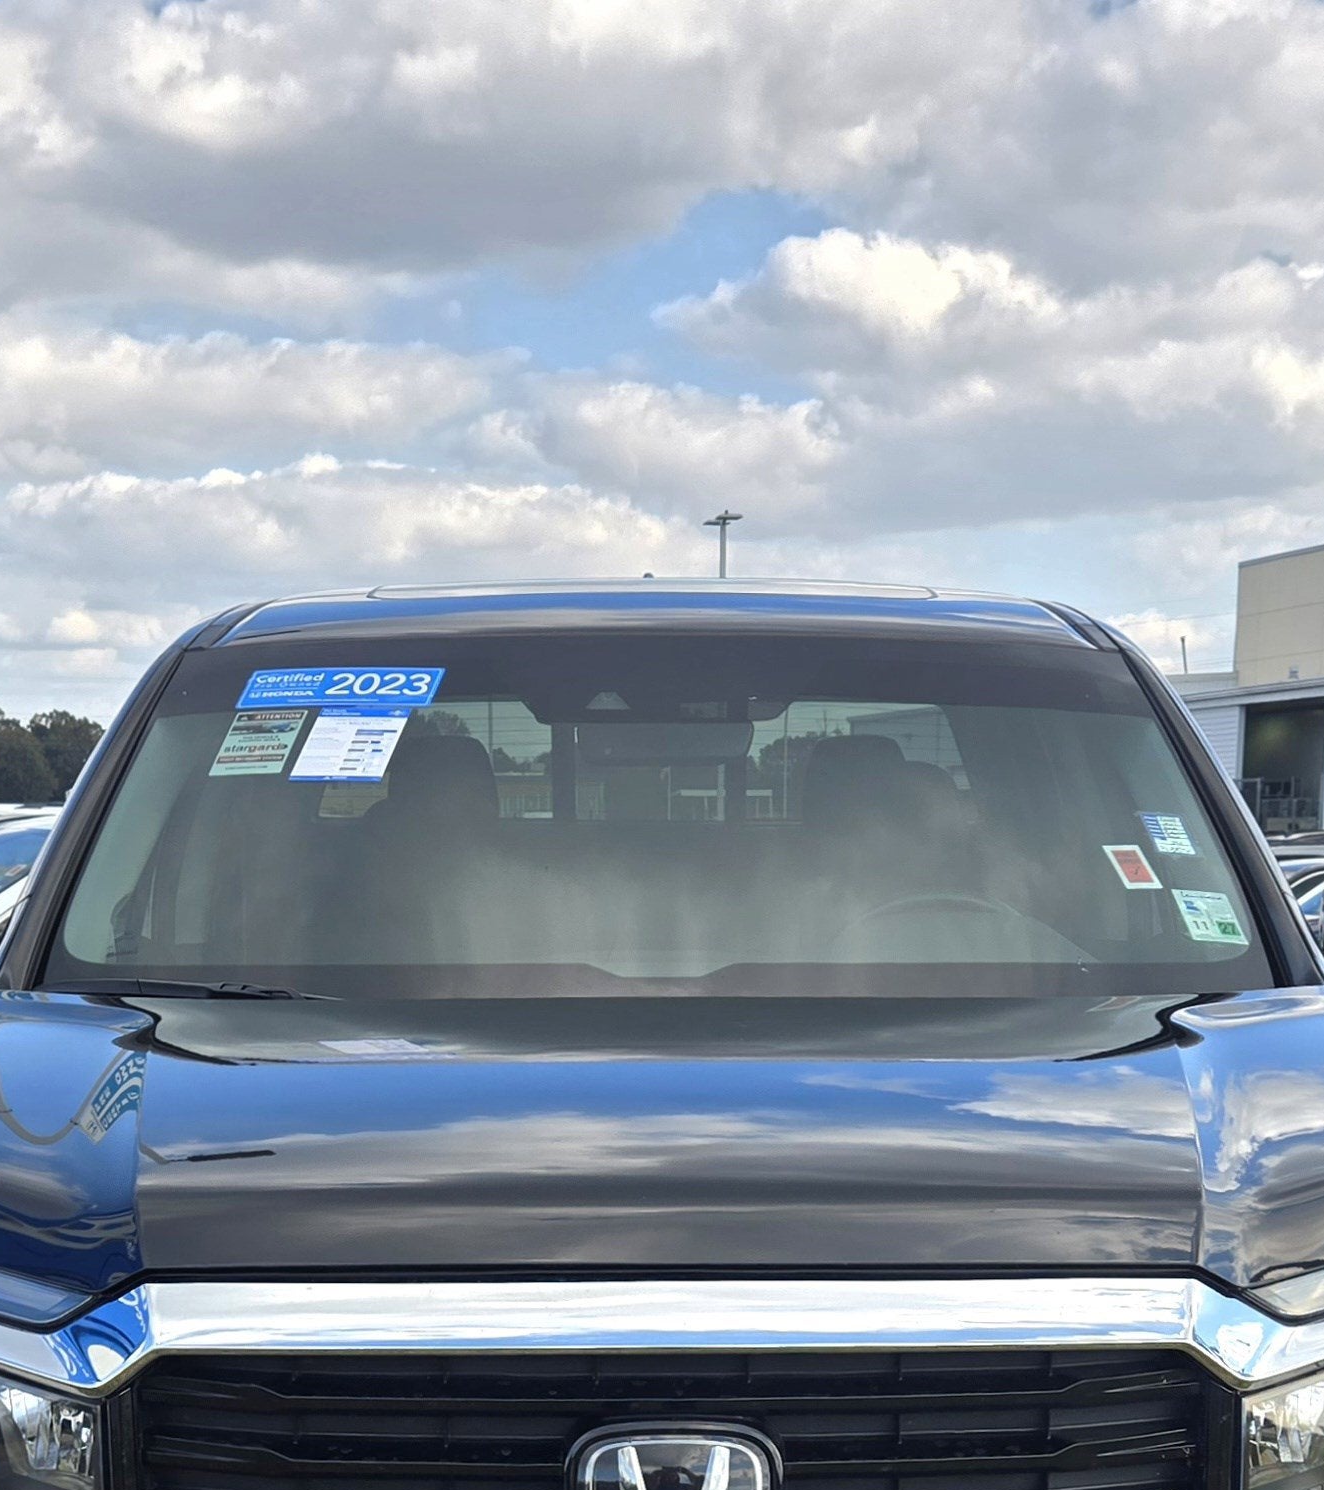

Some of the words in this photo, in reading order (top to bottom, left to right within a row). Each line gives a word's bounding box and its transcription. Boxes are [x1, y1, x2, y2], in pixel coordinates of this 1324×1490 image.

[256, 672, 325, 684] Certified
[325, 672, 432, 696] 2023
[261, 690, 315, 698] HONDA
[254, 713, 302, 721] ATTENTION
